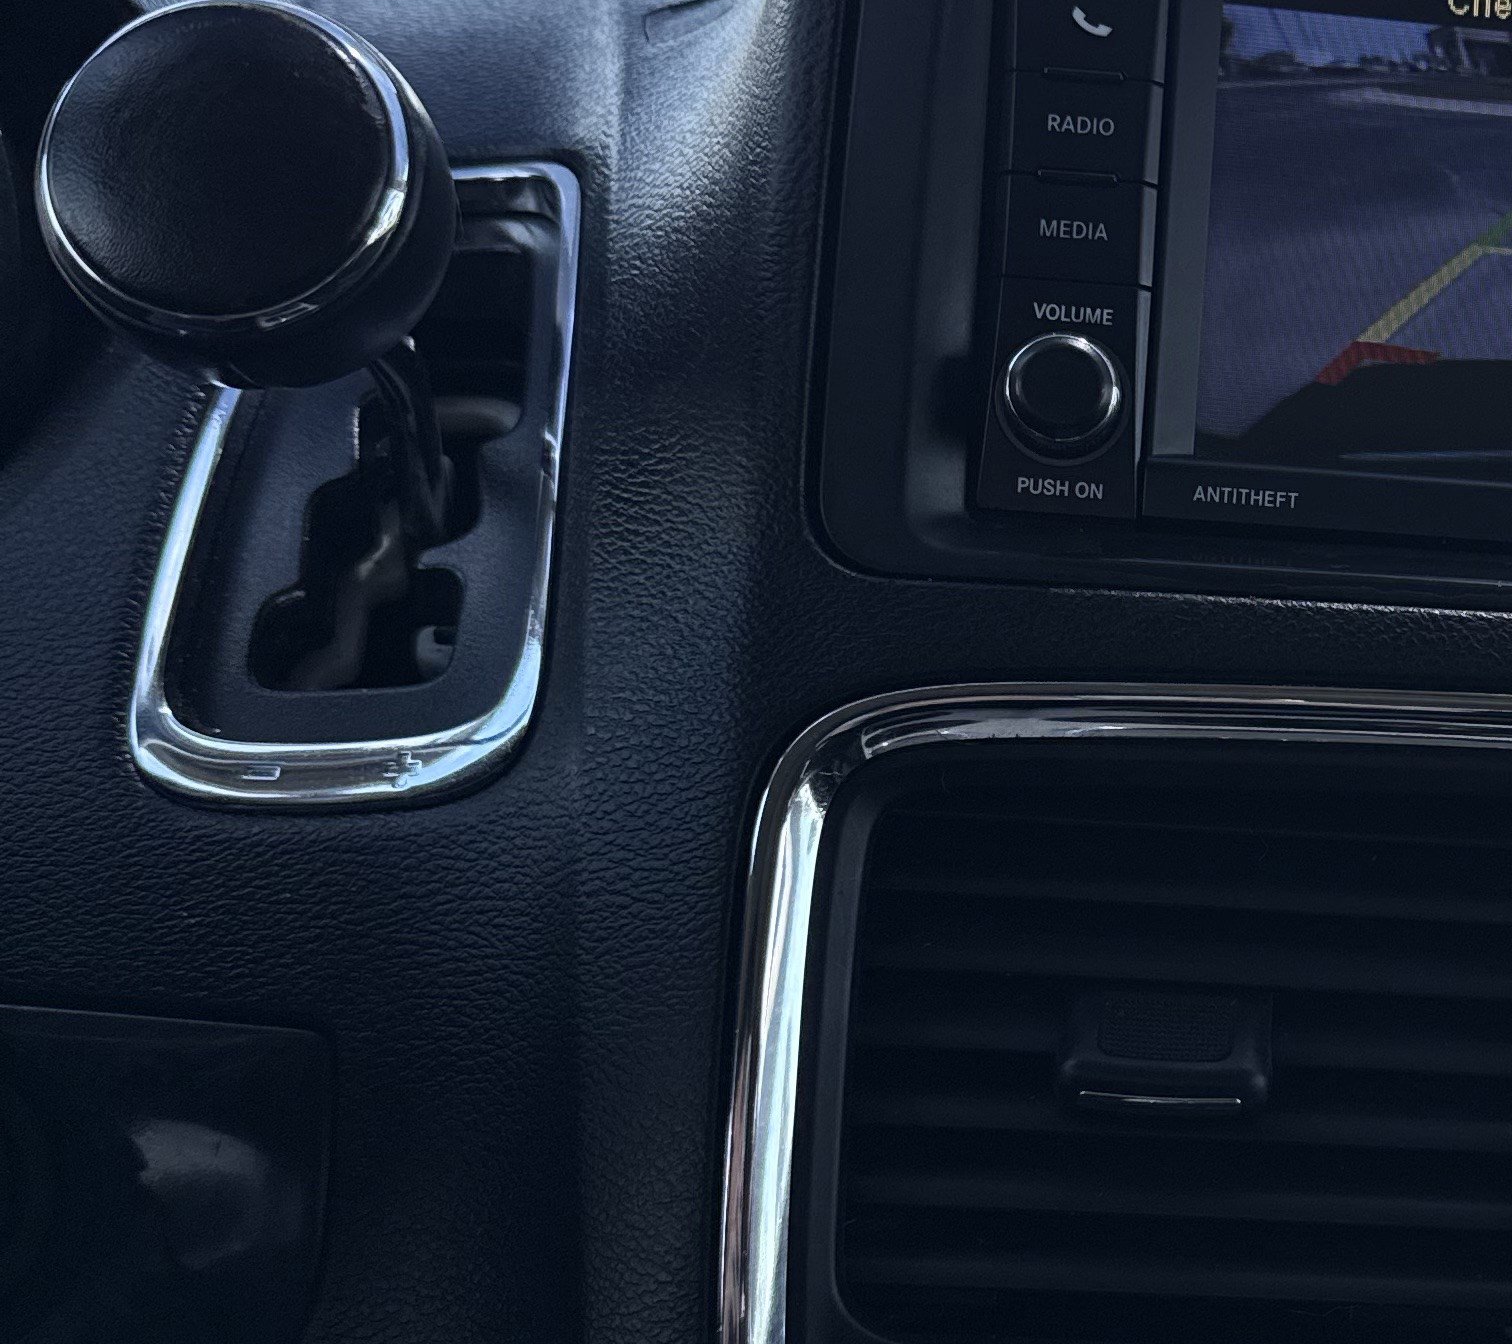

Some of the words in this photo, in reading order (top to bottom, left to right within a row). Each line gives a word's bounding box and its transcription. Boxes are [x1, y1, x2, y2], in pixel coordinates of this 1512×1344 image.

[1047, 113, 1115, 136] RADIO
[1039, 218, 1108, 241] MEDIA
[1033, 301, 1114, 326] VOLUME
[1016, 475, 1070, 498] PUSH
[1074, 479, 1105, 501] ON
[1192, 485, 1299, 509] ANTITHEFT
